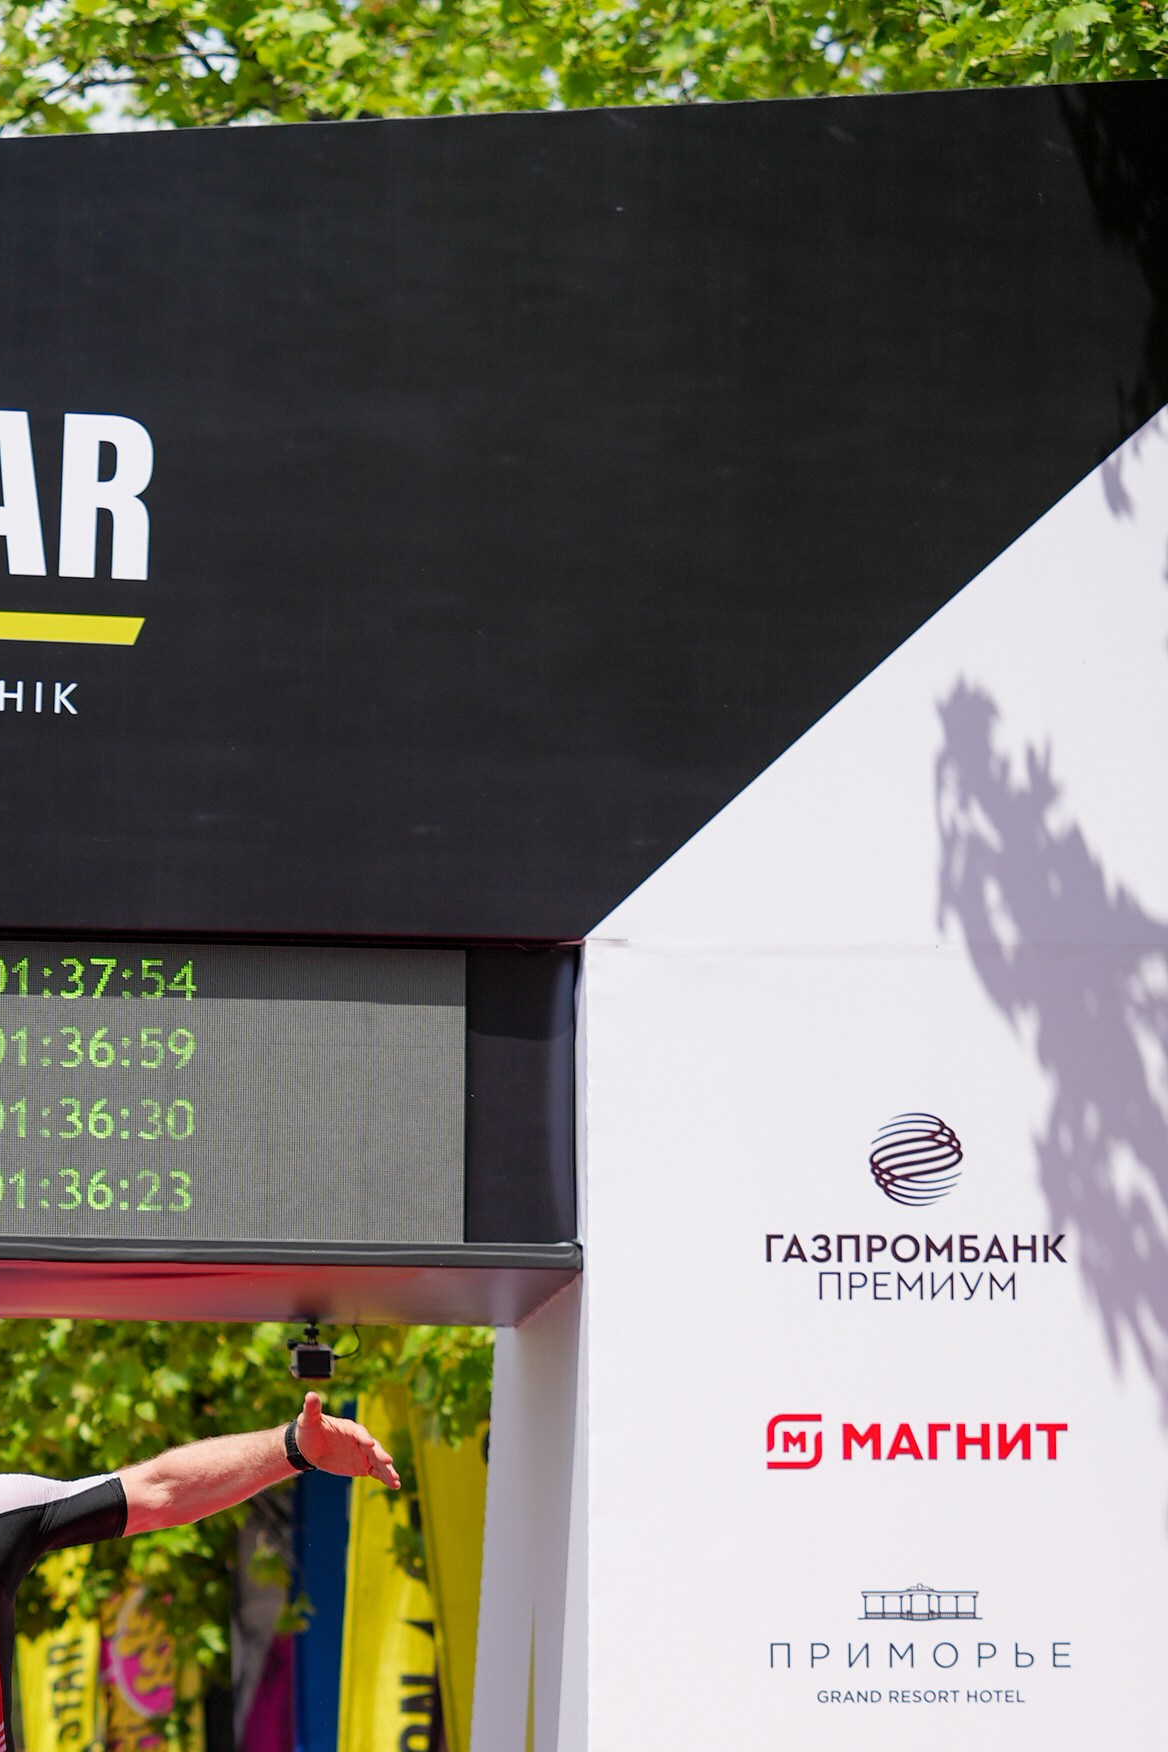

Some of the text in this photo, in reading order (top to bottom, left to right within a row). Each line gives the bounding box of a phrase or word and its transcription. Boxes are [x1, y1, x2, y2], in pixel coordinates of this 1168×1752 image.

[765, 1234, 1068, 1263] ГАЗПРОМБАНК
[818, 1271, 1016, 1300] ПРЕМИУМ
[842, 1423, 1068, 1460] МАГНИТ
[769, 1642, 1072, 1669] ПРИМОРЬЕ
[816, 1690, 1026, 1703] GRAND RESORT HOTEL
